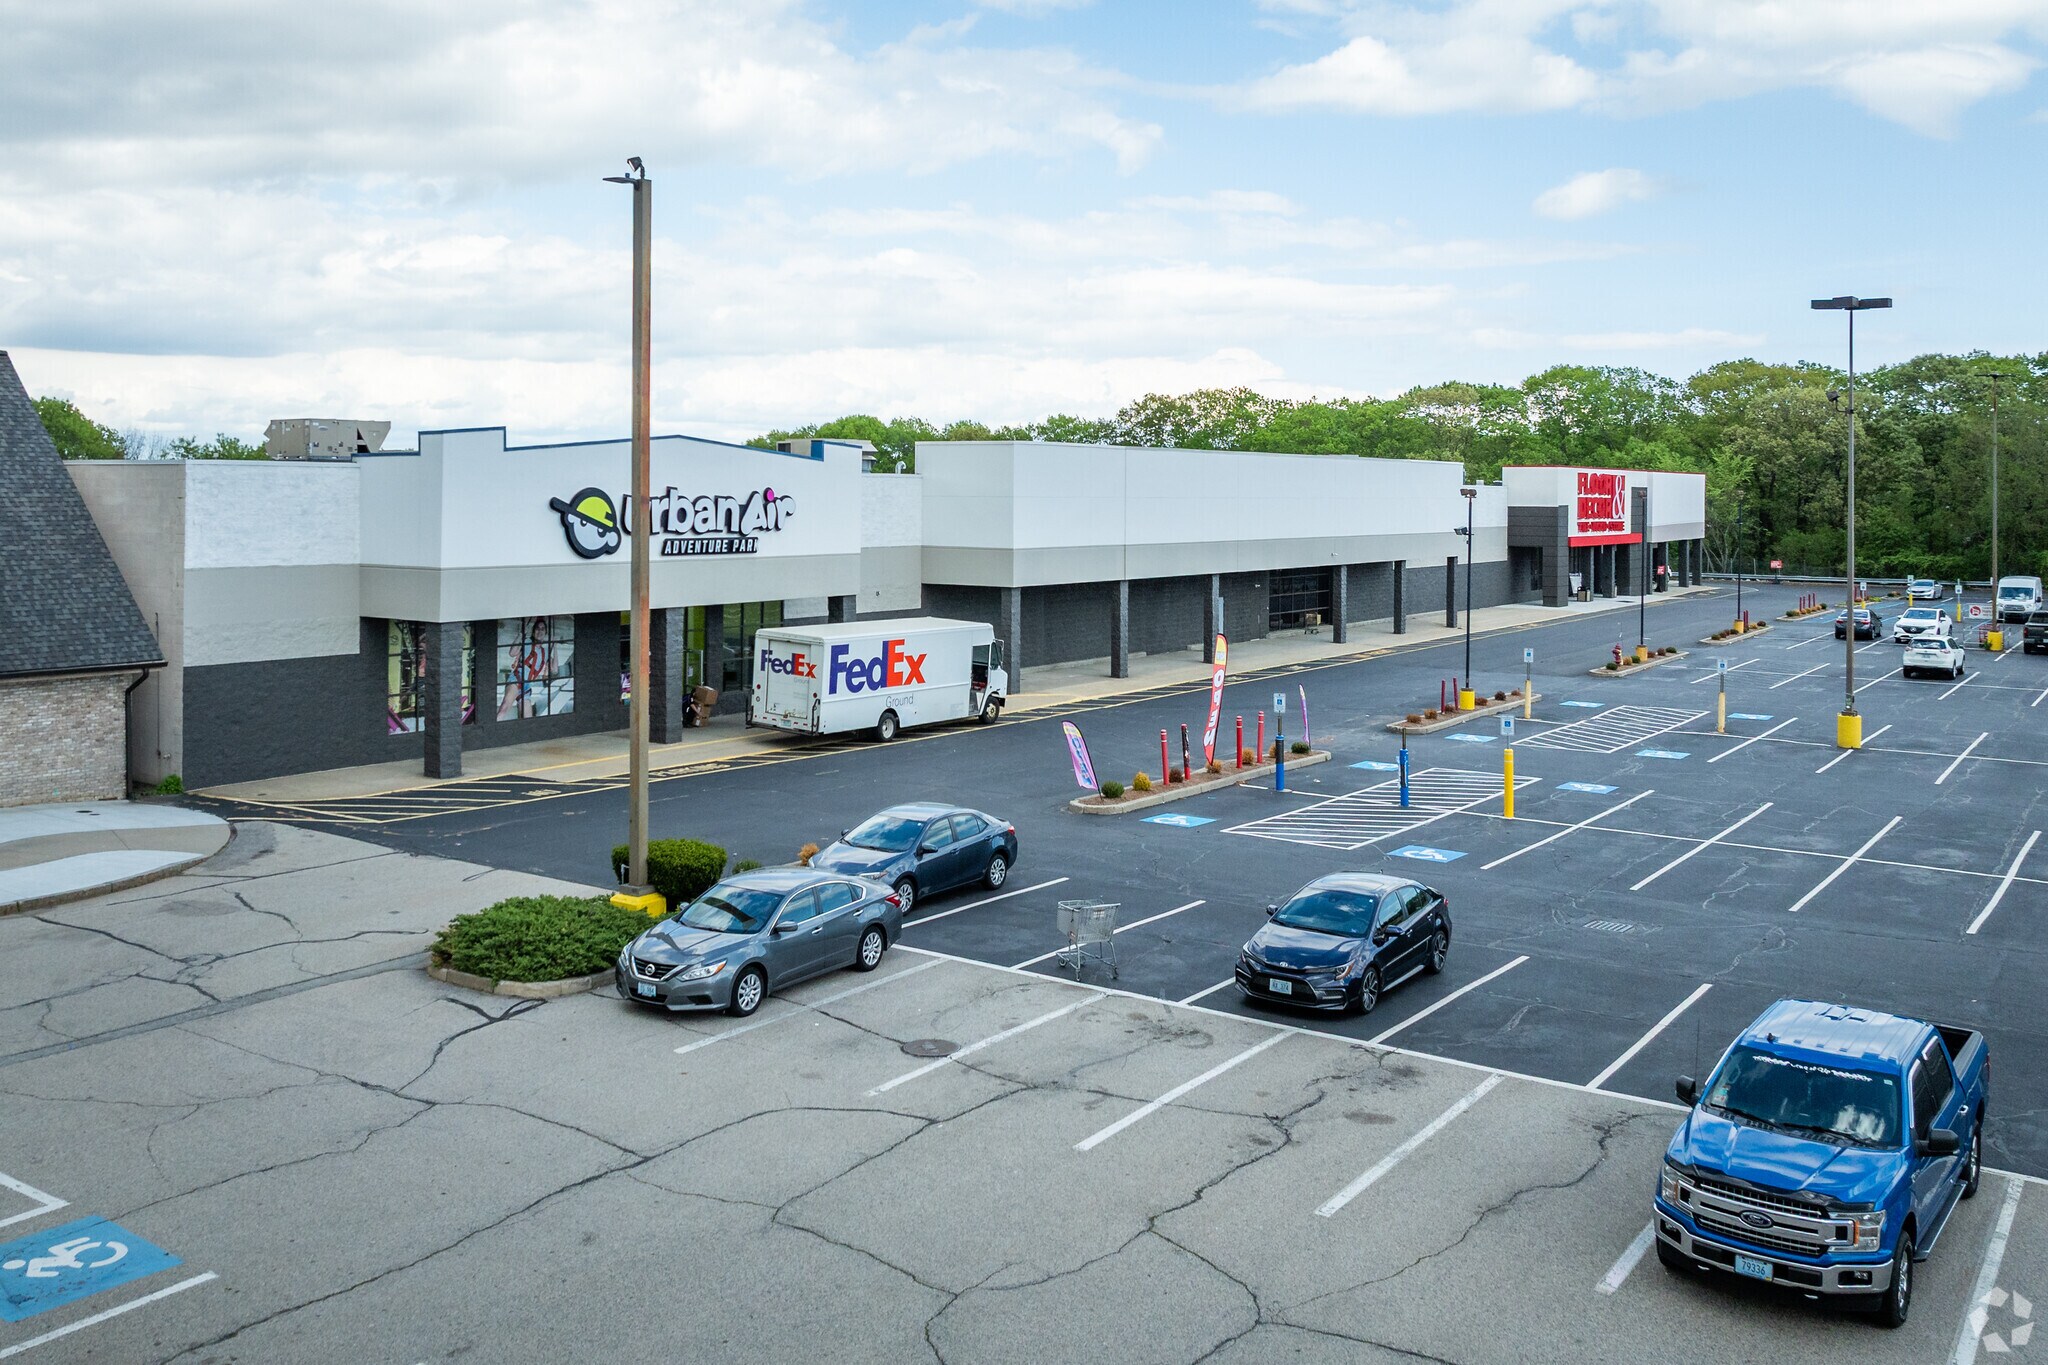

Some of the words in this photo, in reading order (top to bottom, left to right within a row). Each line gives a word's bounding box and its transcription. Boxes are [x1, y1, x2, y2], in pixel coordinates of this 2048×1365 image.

[1577, 472, 1612, 496] FLOOR
[740, 486, 797, 536] Air
[1577, 497, 1612, 520] DECOR
[664, 539, 728, 555] ADVENTURE
[760, 649, 817, 679] FedEx
[828, 638, 928, 695] FedEx
[885, 693, 914, 708] Ground
[1741, 1260, 1766, 1276] 79336
